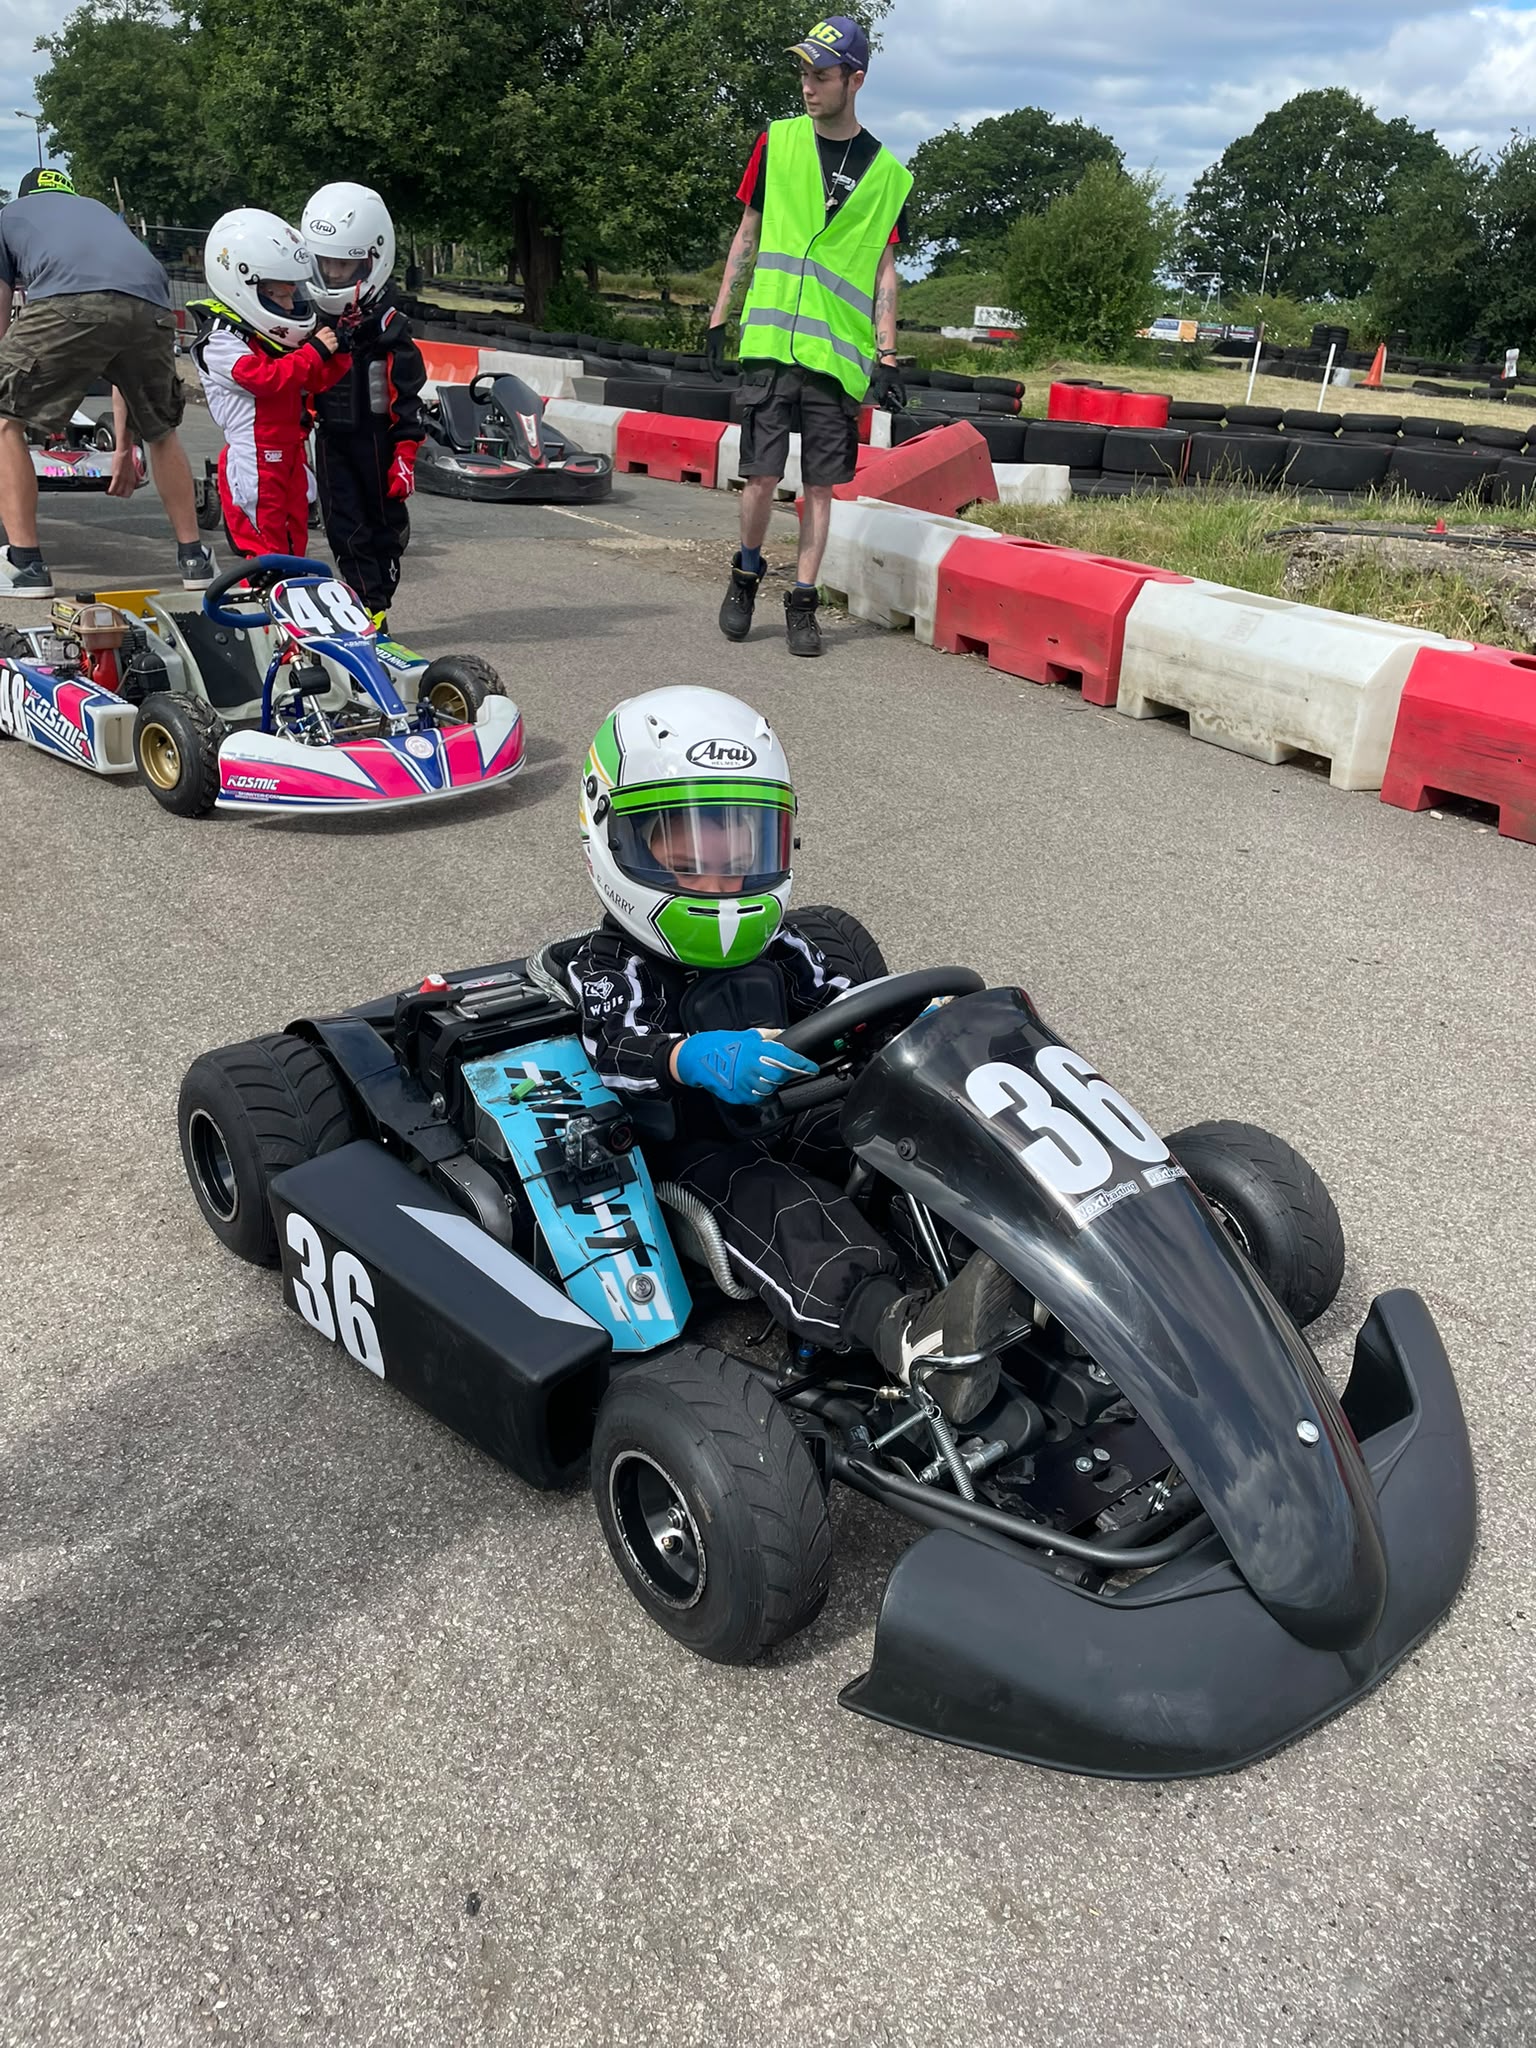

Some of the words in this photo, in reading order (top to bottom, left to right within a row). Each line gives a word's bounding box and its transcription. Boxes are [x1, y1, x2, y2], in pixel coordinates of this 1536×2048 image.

[808, 21, 844, 44] 46
[311, 221, 334, 233] Arai
[286, 581, 371, 634] 48
[0, 669, 28, 737] 48
[25, 689, 88, 752] KOSMIC
[693, 741, 750, 761] Arai
[227, 775, 280, 791] KOSMIC
[604, 884, 635, 915] GARRY
[965, 1046, 1170, 1194] 36
[1078, 1193, 1107, 1219] Next
[1106, 1183, 1137, 1202] karting
[286, 1212, 385, 1379] 36
